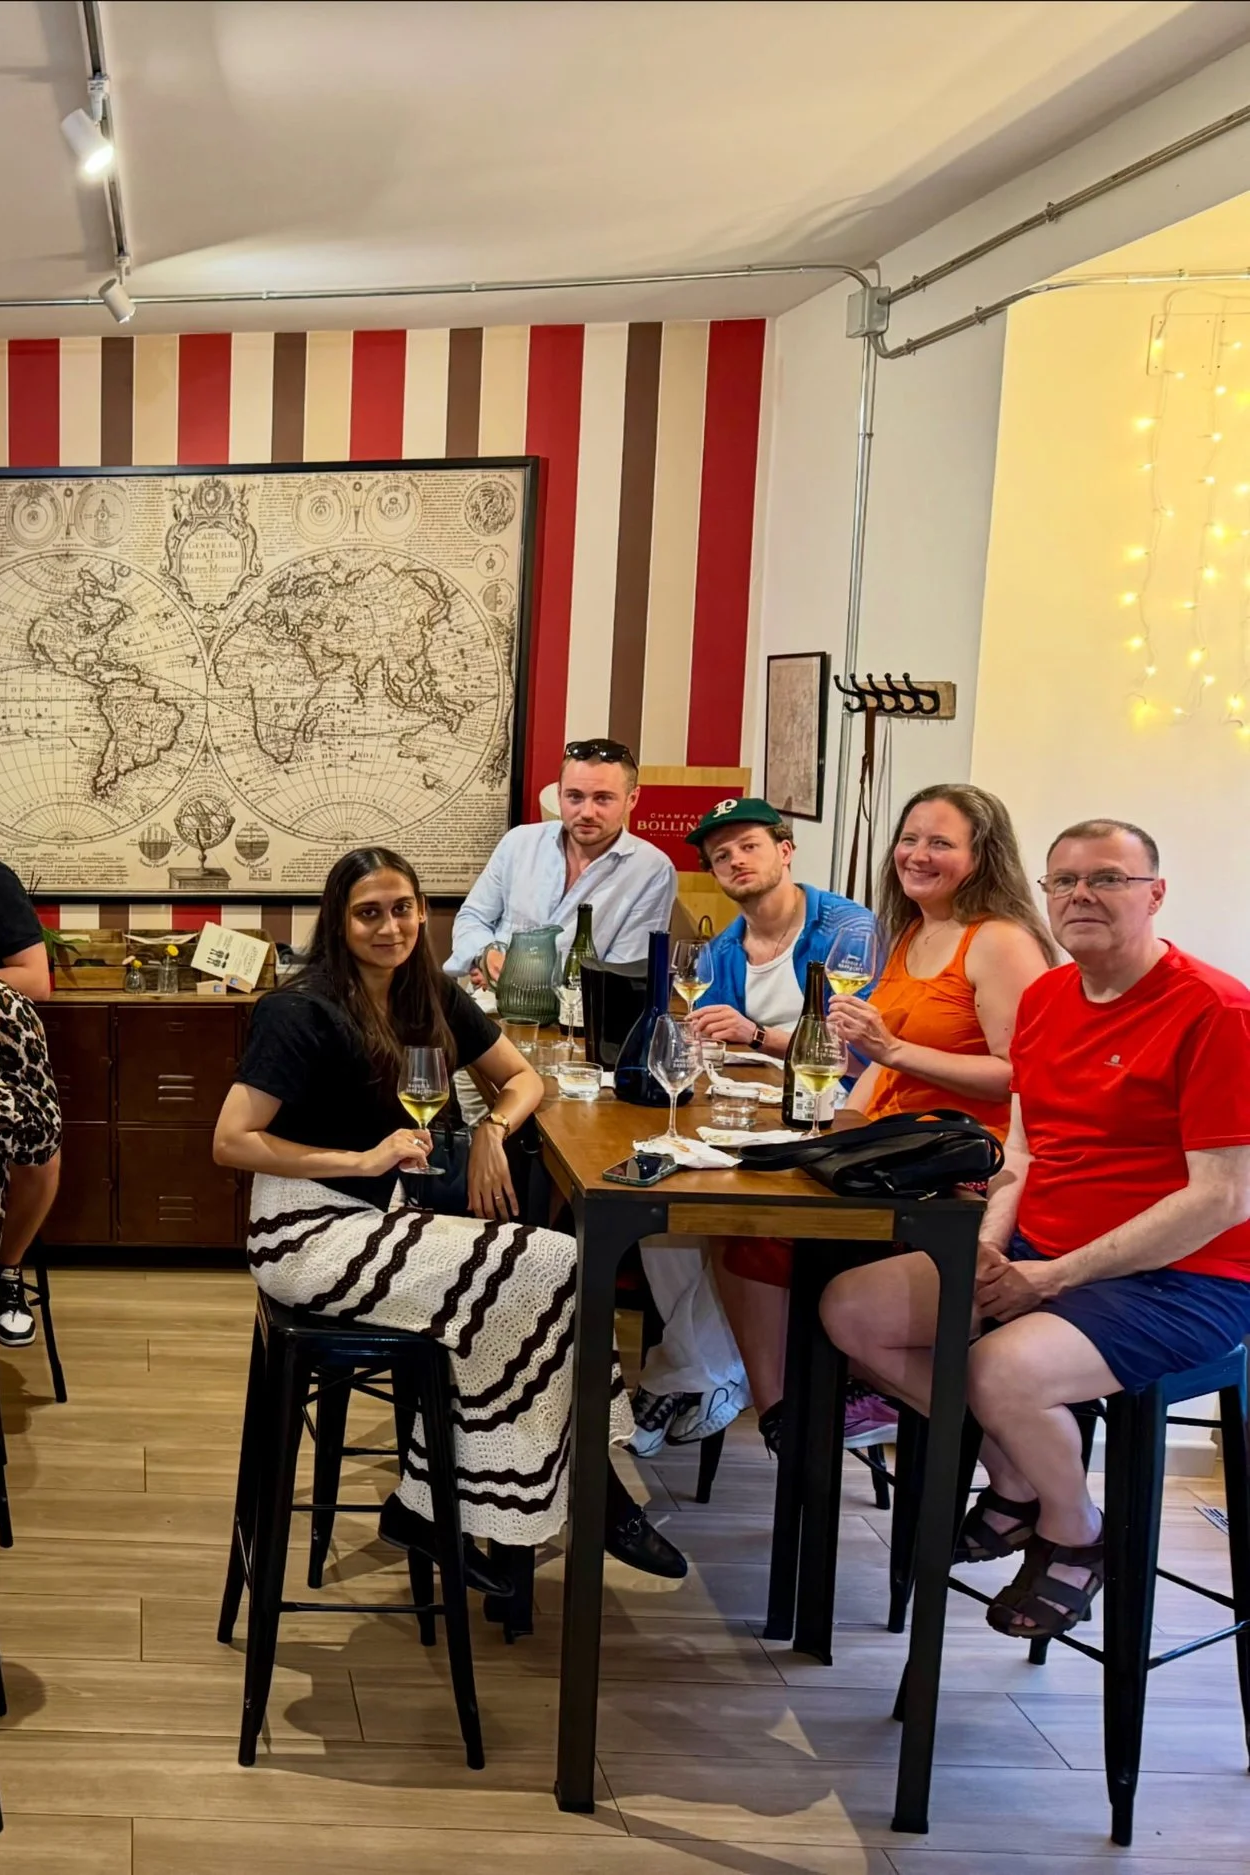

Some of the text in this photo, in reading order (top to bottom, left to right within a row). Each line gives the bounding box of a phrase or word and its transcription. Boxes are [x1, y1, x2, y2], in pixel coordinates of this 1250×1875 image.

[713, 798, 738, 818] P
[650, 812, 703, 820] CHAMPAG
[637, 820, 699, 831] BOLLIN
